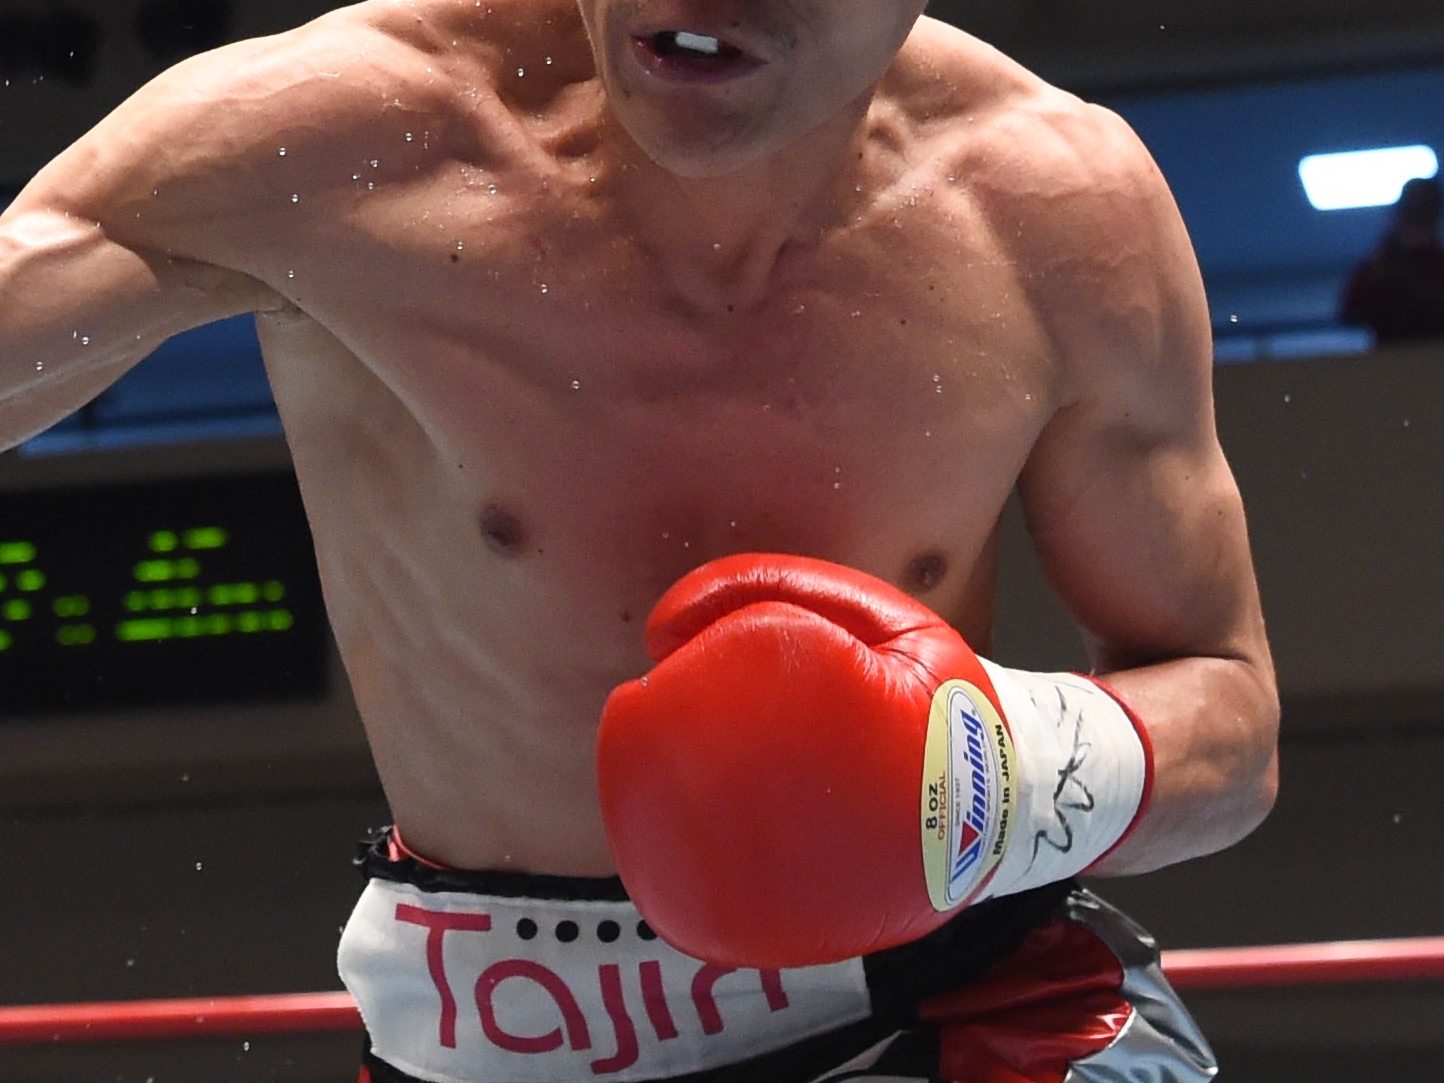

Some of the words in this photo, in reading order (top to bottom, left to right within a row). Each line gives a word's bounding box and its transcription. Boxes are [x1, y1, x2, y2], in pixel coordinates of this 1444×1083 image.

[994, 724, 1011, 782] JAPAN
[937, 771, 947, 841] OFFICIAL
[950, 709, 986, 884] Winning
[1002, 786, 1010, 804] in
[925, 816, 938, 831] 8
[993, 809, 1009, 855] Made
